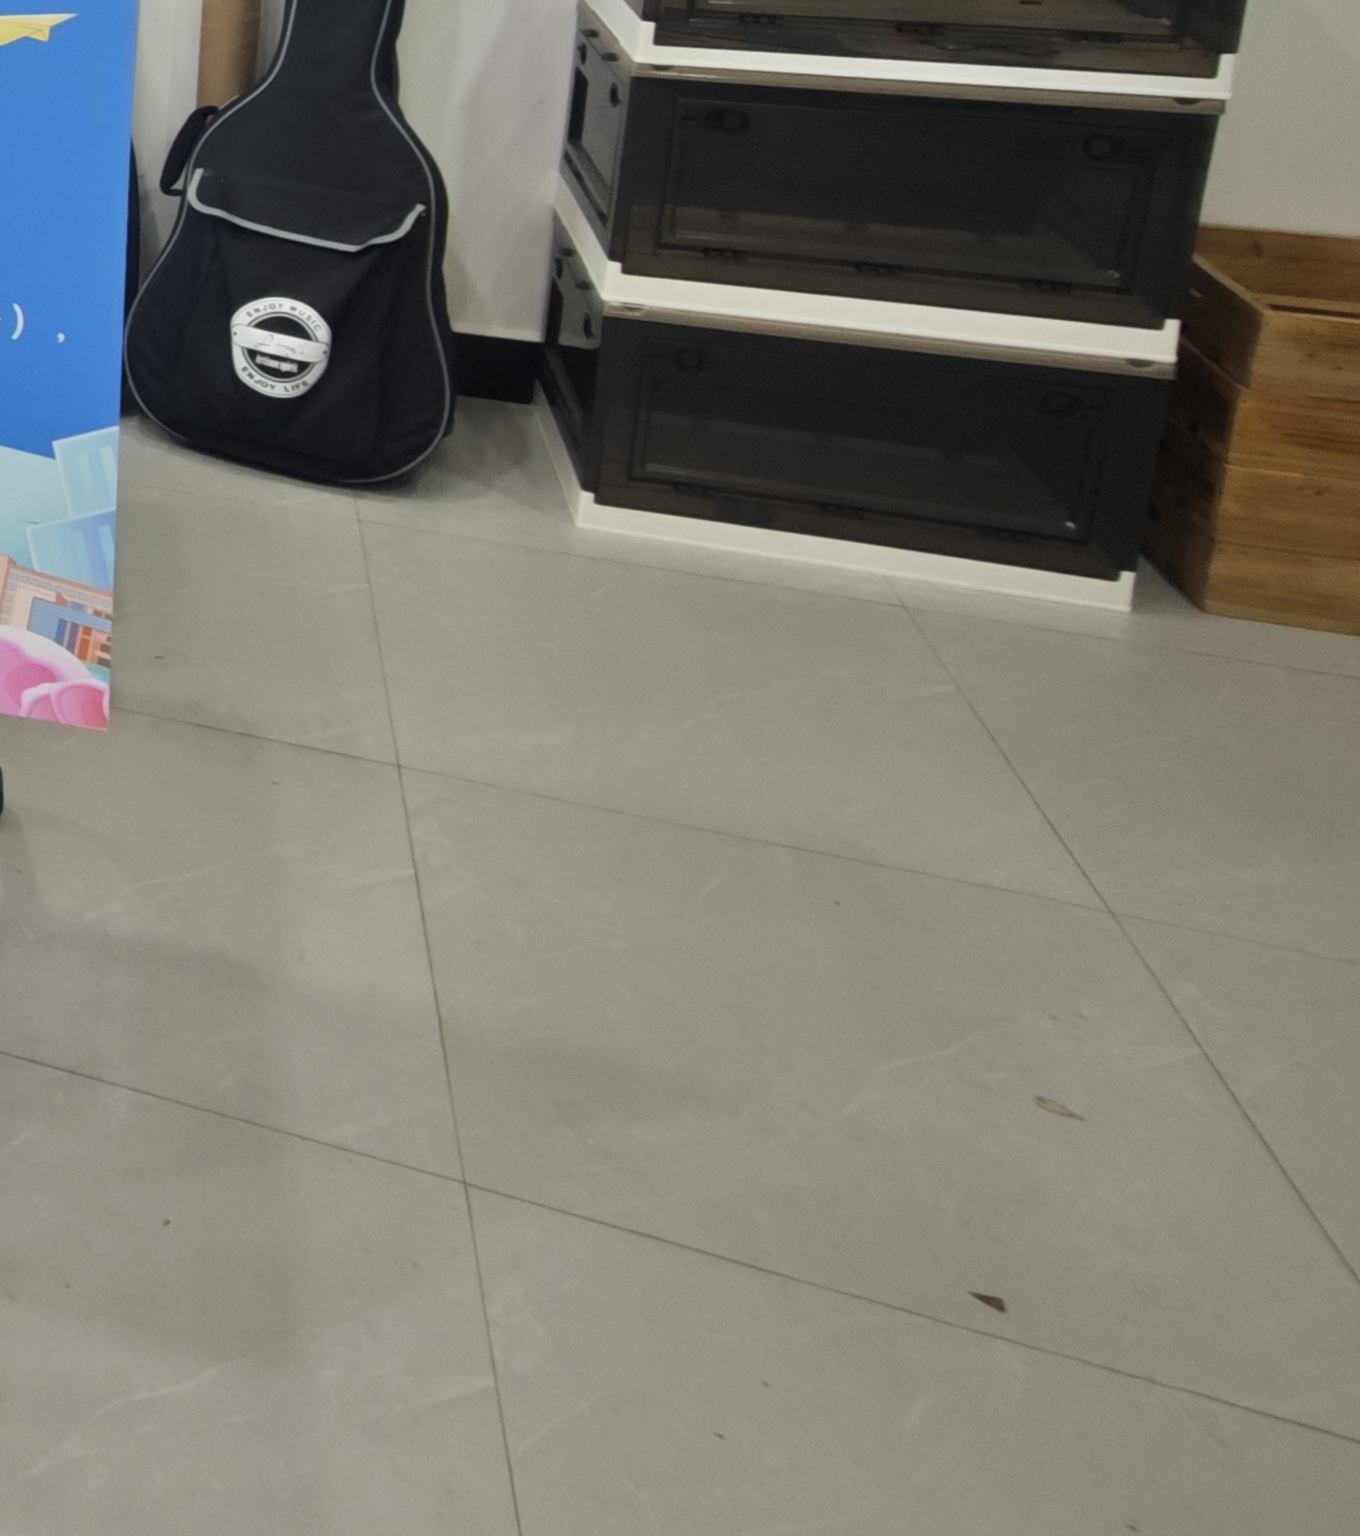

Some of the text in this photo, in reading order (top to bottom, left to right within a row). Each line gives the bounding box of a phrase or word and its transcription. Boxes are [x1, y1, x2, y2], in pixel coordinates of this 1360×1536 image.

[245, 302, 323, 332] ENJOY MUSIC
[240, 365, 310, 393] ENJOY LIFE
